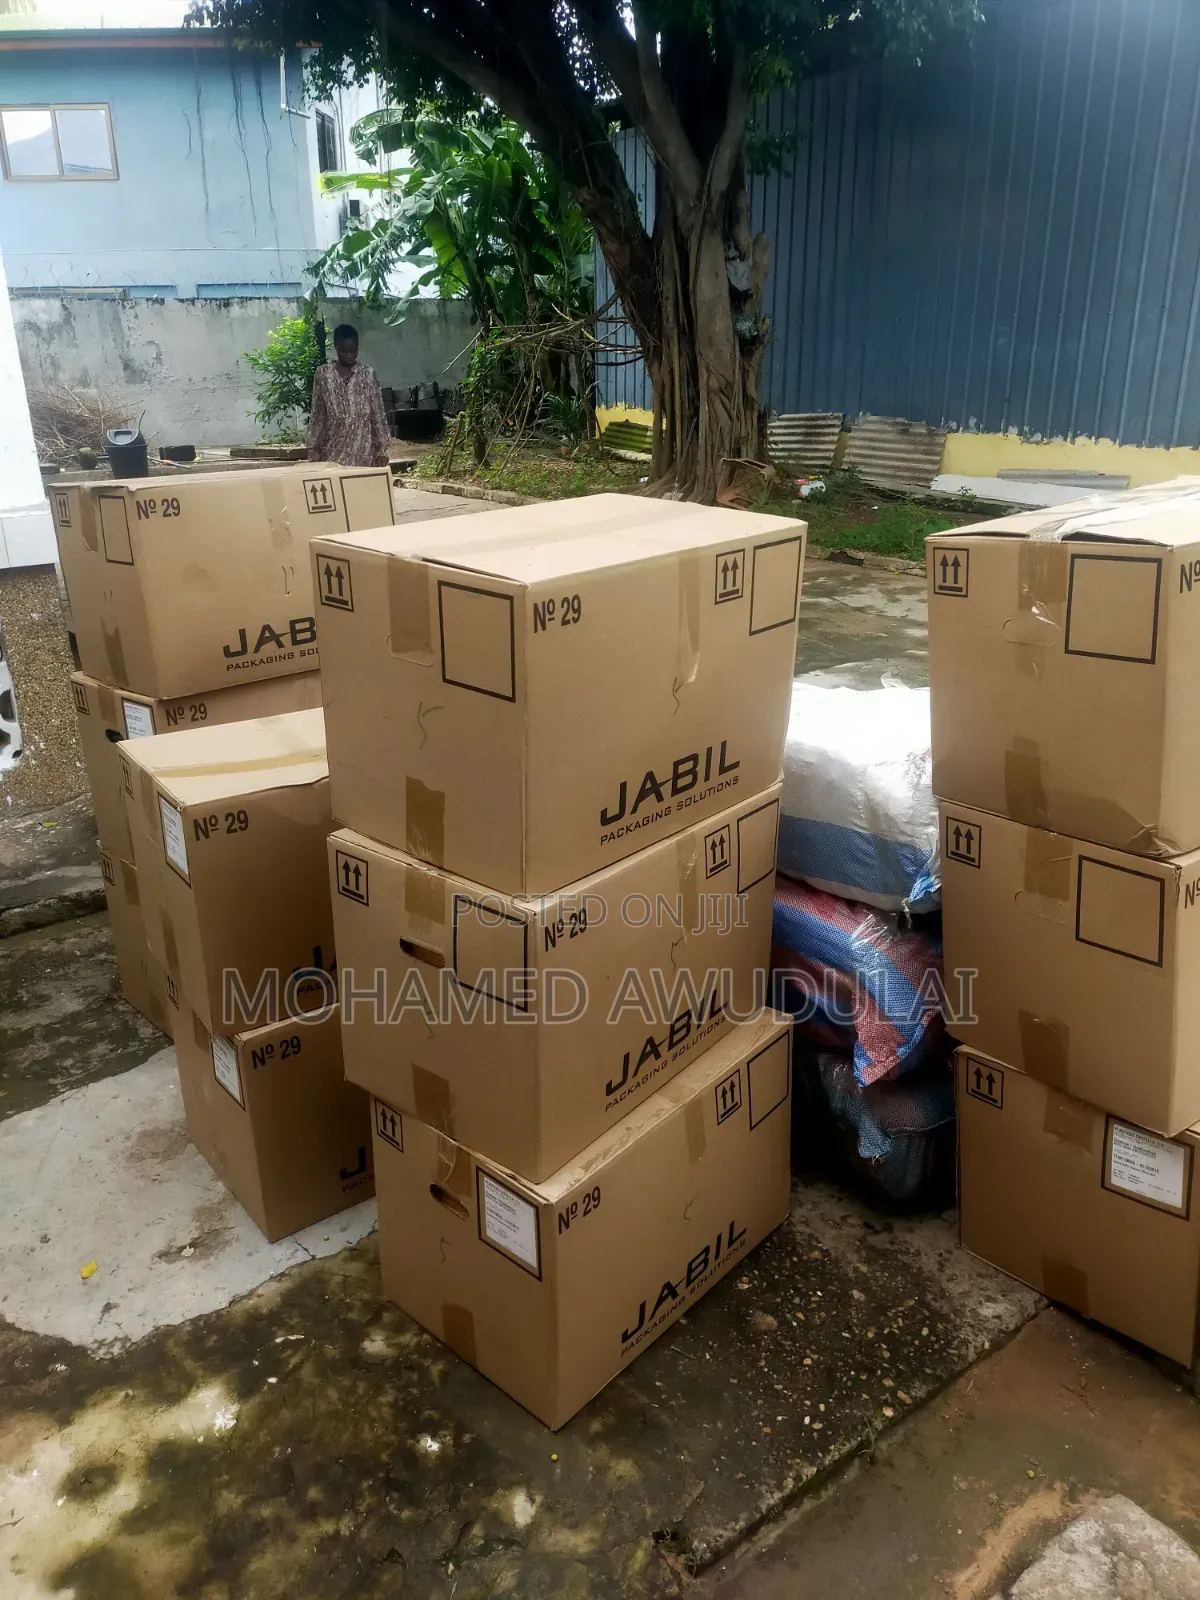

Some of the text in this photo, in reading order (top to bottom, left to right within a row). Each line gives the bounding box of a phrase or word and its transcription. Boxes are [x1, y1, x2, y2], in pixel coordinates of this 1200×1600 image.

[161, 498, 181, 518] 29
[561, 594, 582, 627] 29
[223, 617, 317, 659] JAB
[226, 652, 295, 672] PACKAGING
[189, 702, 208, 722] 29
[600, 740, 740, 827] JABIL
[224, 809, 249, 835] 29
[600, 775, 739, 846] PACKAGING SOLUTIONS
[569, 907, 588, 939] 29
[279, 1035, 302, 1060] 29
[605, 988, 729, 1097] JABIL
[605, 1014, 727, 1112] PACKAGING SOLUTIONS
[582, 1185, 602, 1218] 29
[621, 1220, 747, 1344] JABIL
[621, 1238, 746, 1358] PACKAGING SOLUTIONS
